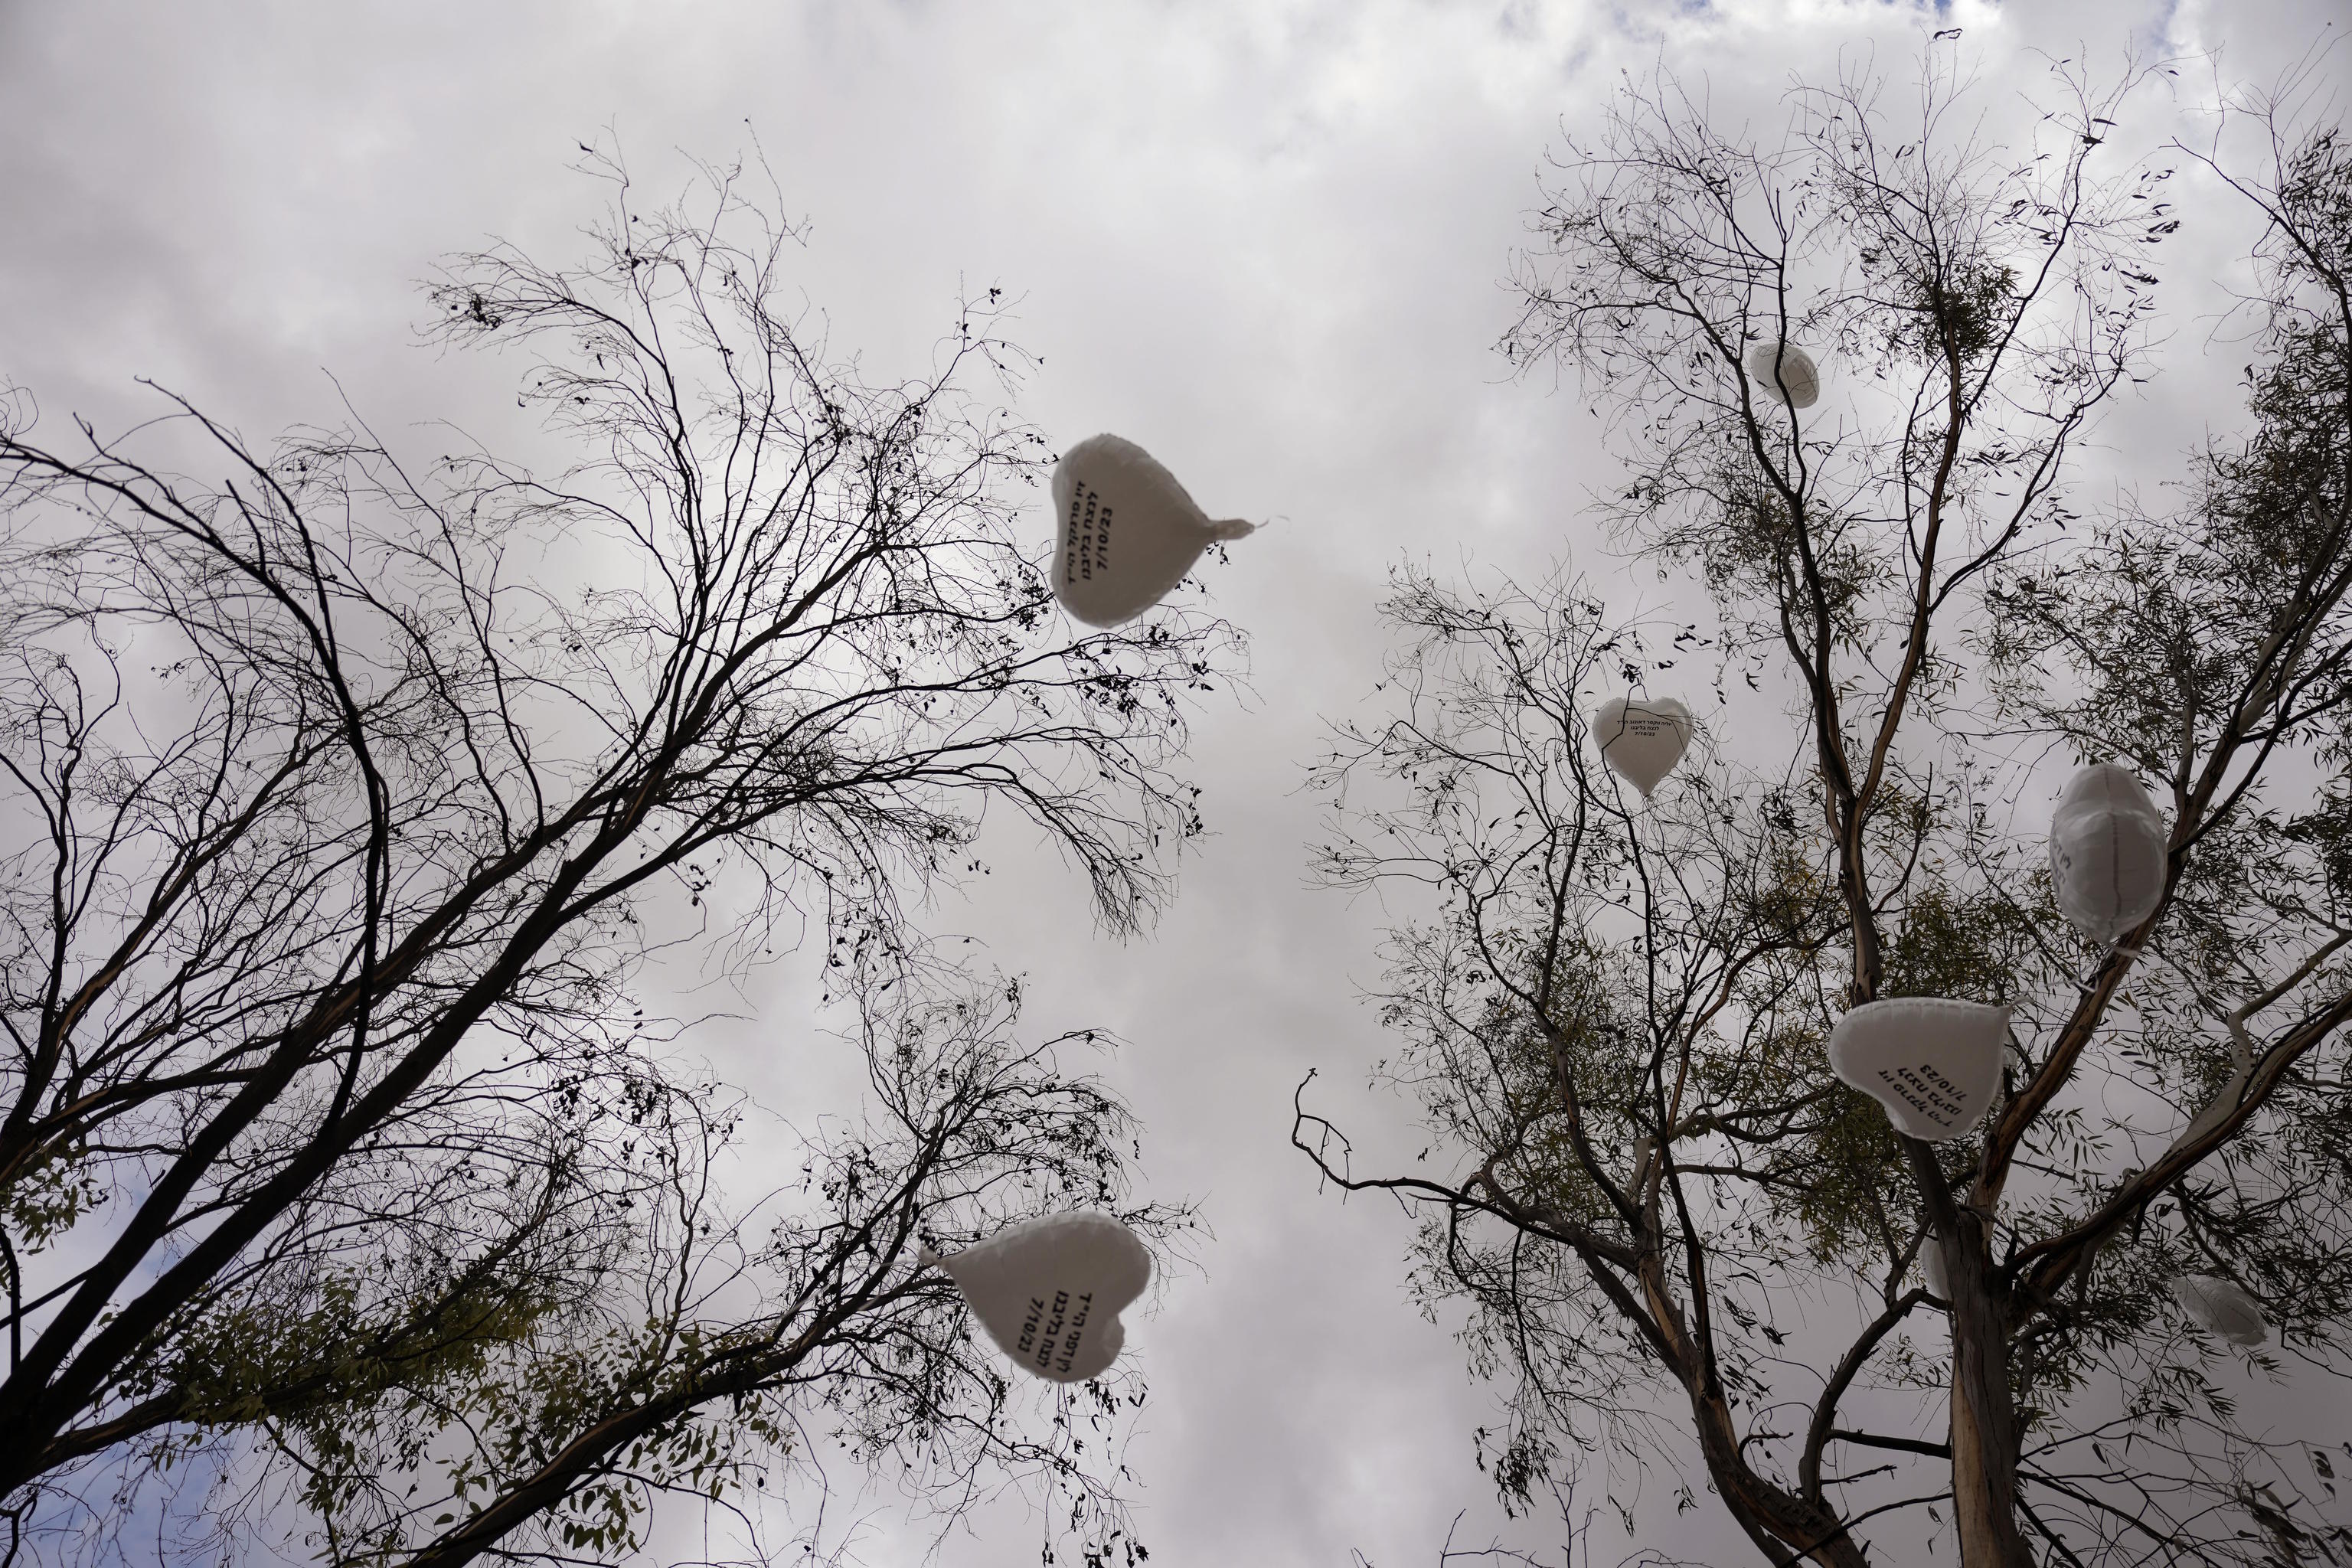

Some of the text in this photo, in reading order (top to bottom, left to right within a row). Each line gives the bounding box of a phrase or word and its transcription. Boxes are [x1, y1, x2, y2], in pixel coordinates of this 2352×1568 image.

[1075, 481, 1086, 498] זיו
[1067, 501, 1080, 547] פרנקל
[1080, 492, 1098, 580] לנצח בליבנו
[1096, 508, 1112, 570] 7/10/23
[1878, 1070, 1895, 1083] זיו
[1893, 1083, 1928, 1112] פרנקל
[1897, 1067, 1962, 1116] לנצח בליבנו
[1919, 1064, 1967, 1101] 7/10/23
[1018, 1298, 1044, 1353] 7/10/23
[1037, 1291, 1069, 1367] לנצח בליבנו
[1063, 1331, 1081, 1357] דפני
[1056, 1357, 1071, 1373] לין
